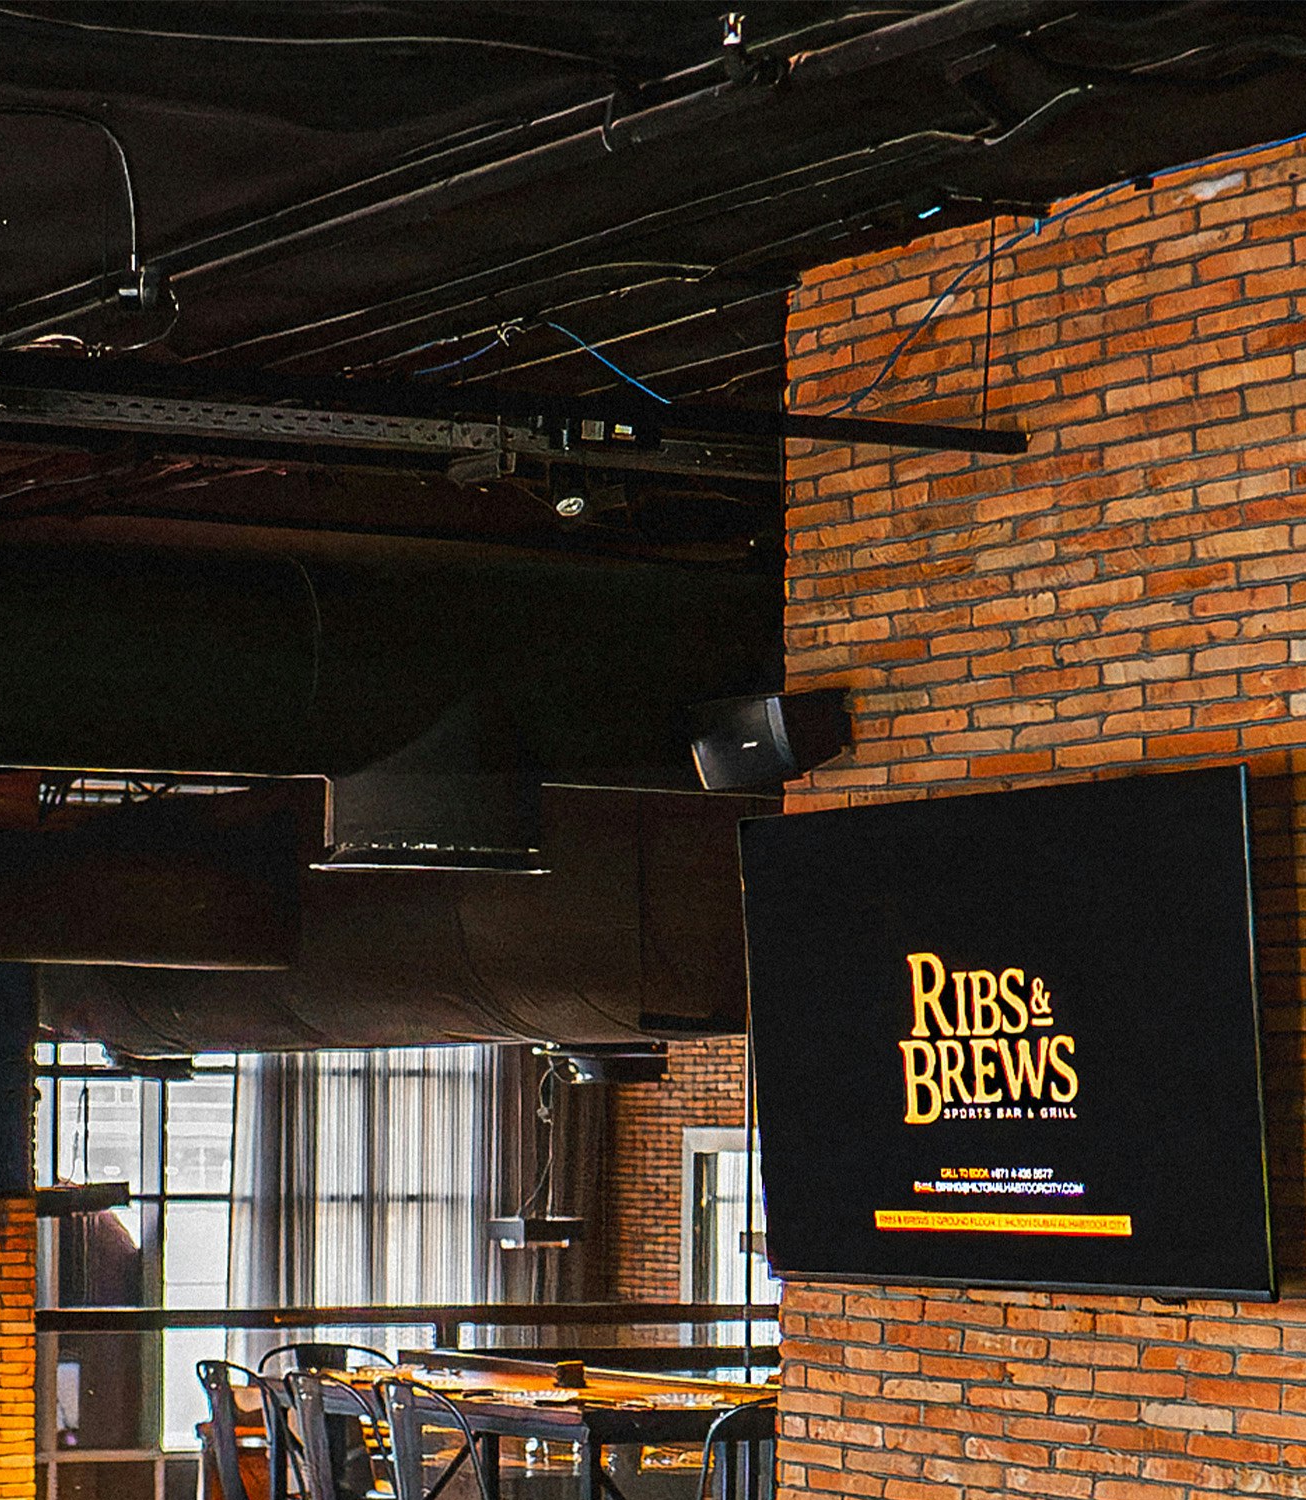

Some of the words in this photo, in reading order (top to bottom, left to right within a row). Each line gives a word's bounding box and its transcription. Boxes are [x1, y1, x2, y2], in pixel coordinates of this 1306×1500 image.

[906, 952, 1029, 1037] RIBS
[1030, 977, 1053, 1016] &
[898, 1035, 1079, 1125] BREWS
[943, 1107, 992, 1119] SPORTS
[996, 1107, 1022, 1119] BAR
[1039, 1107, 1077, 1119] GRILL
